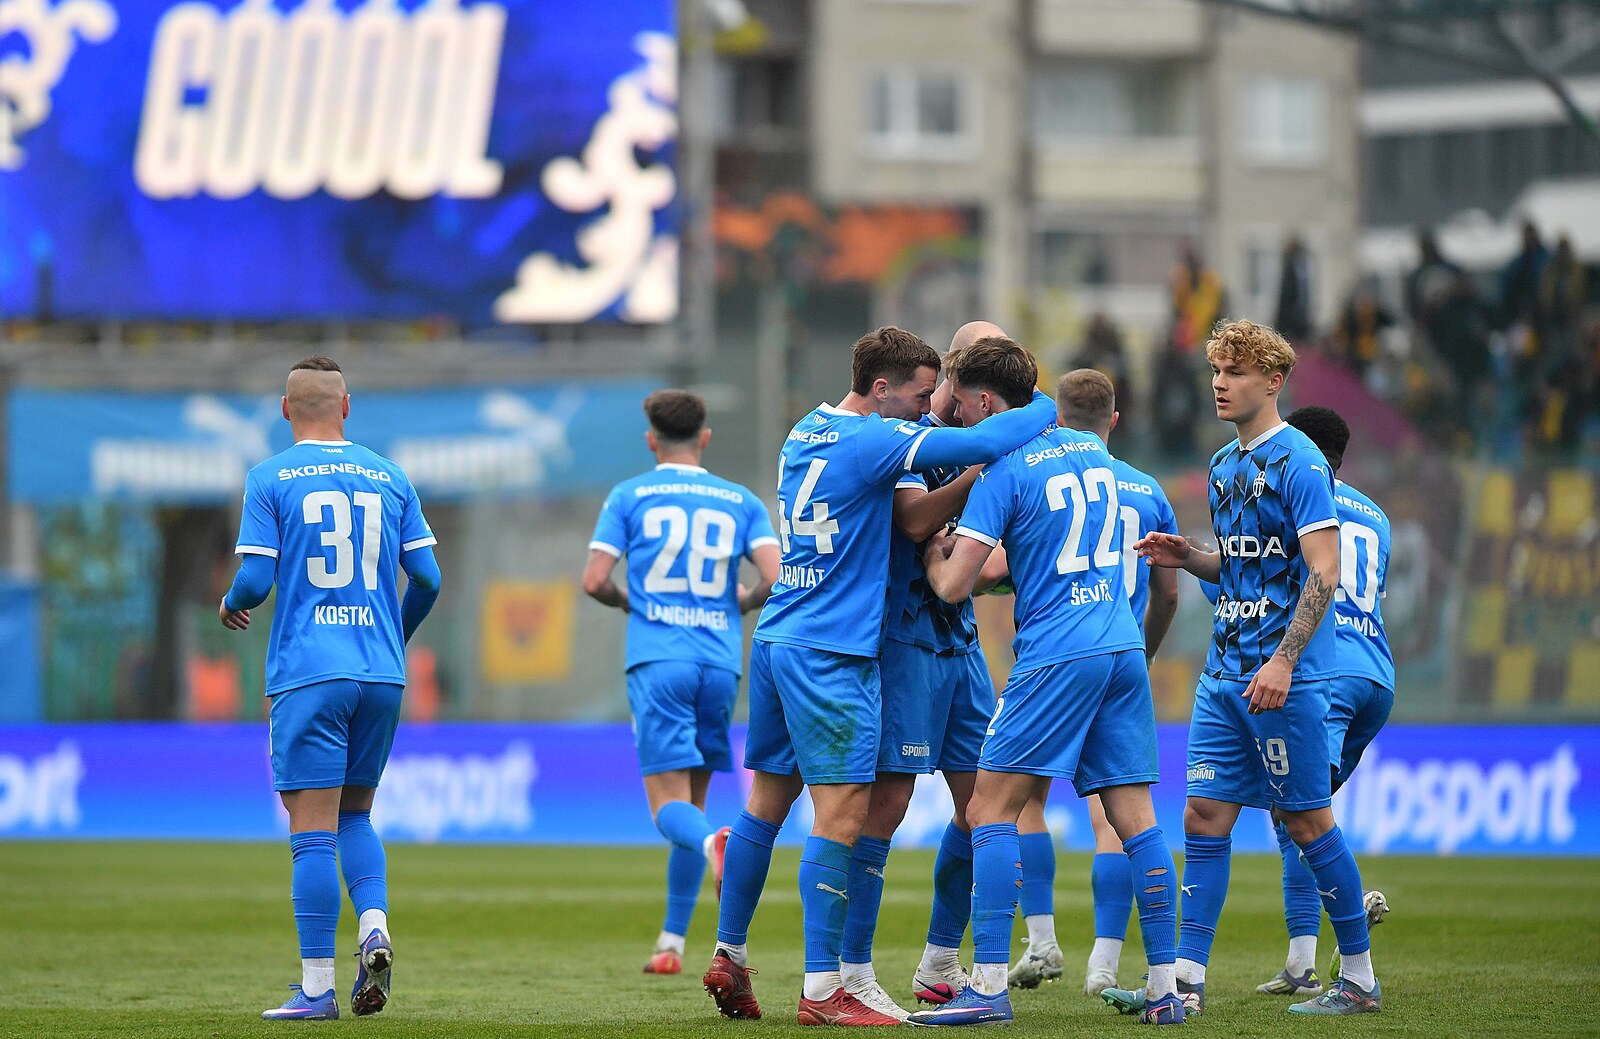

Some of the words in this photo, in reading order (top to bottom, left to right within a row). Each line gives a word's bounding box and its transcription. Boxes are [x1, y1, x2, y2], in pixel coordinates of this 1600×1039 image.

[277, 463, 391, 483] ŠKOENERGO
[302, 490, 382, 591] 31
[643, 505, 737, 598] 28
[1046, 467, 1120, 575] 22
[1334, 521, 1379, 613] 0
